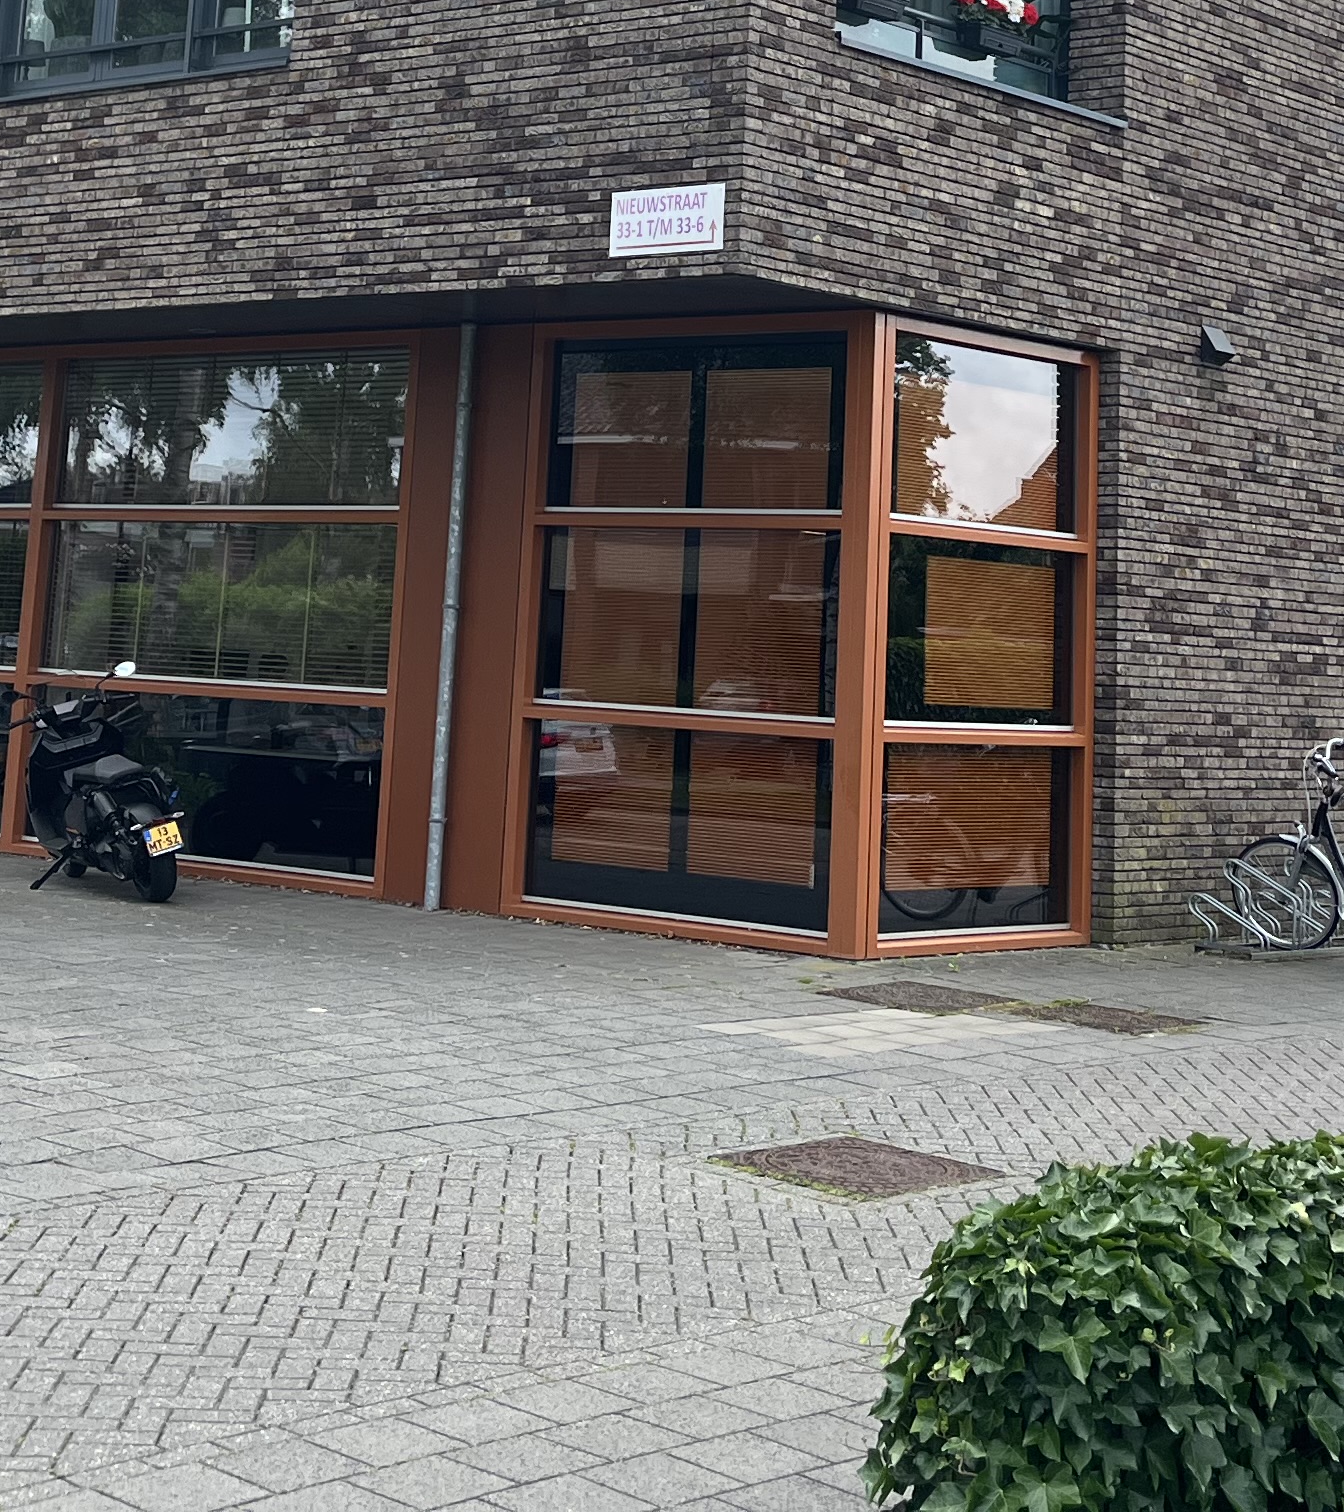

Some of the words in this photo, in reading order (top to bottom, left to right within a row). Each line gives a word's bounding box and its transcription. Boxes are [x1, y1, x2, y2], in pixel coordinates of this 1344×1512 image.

[616, 192, 708, 216] NIEUWSTRAAT
[617, 220, 643, 239] 33-1
[647, 217, 673, 240] T/M
[676, 216, 704, 235] 33-6
[157, 826, 168, 837] 13
